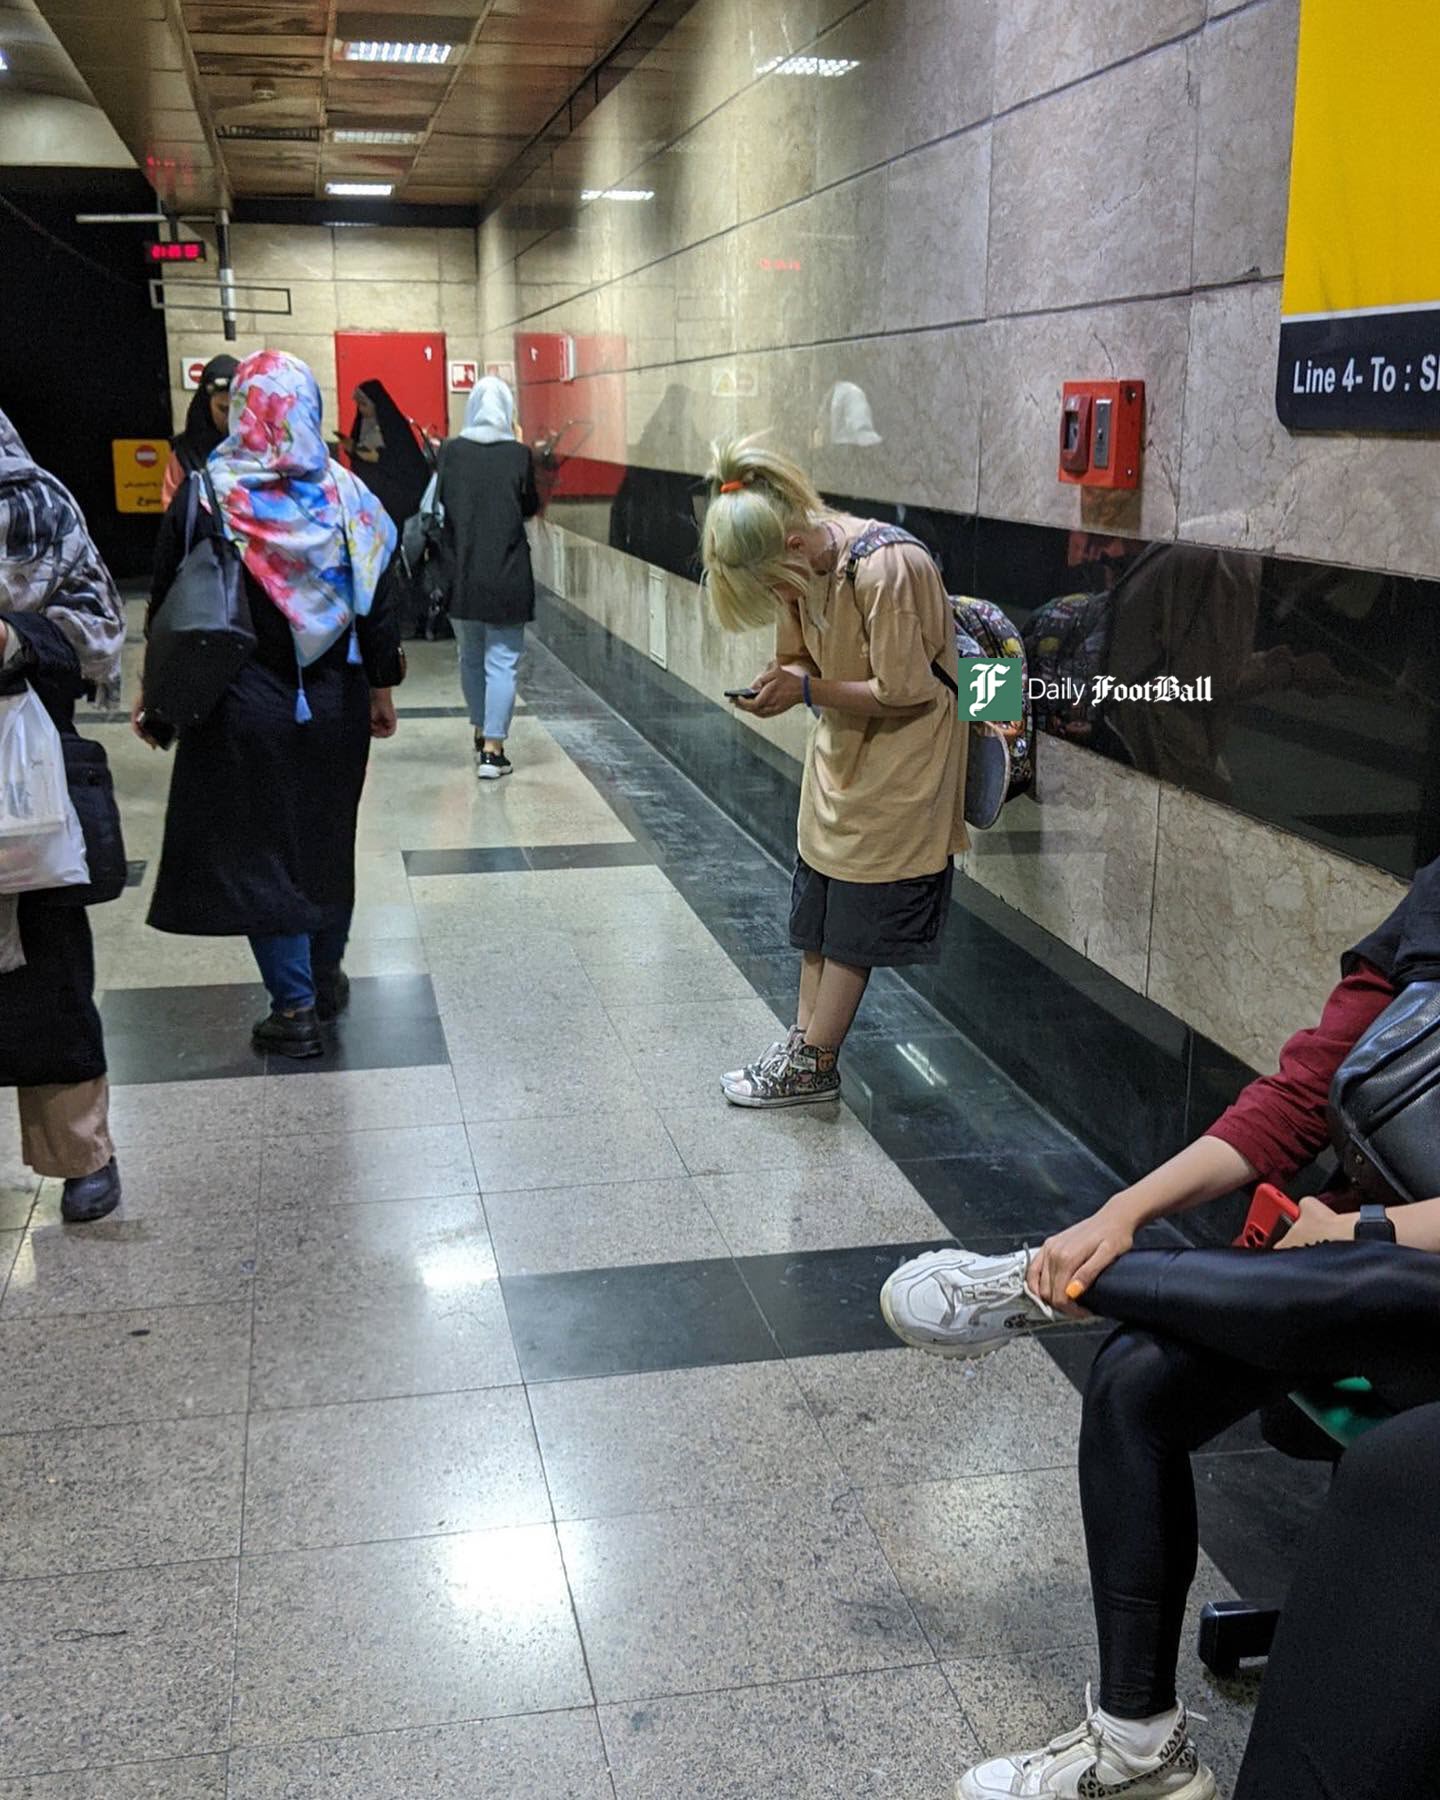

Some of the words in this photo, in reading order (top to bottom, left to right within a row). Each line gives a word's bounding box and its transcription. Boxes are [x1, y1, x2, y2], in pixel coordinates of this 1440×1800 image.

[1293, 359, 1336, 394] Line
[1370, 356, 1397, 393] To
[1419, 353, 1440, 393] S
